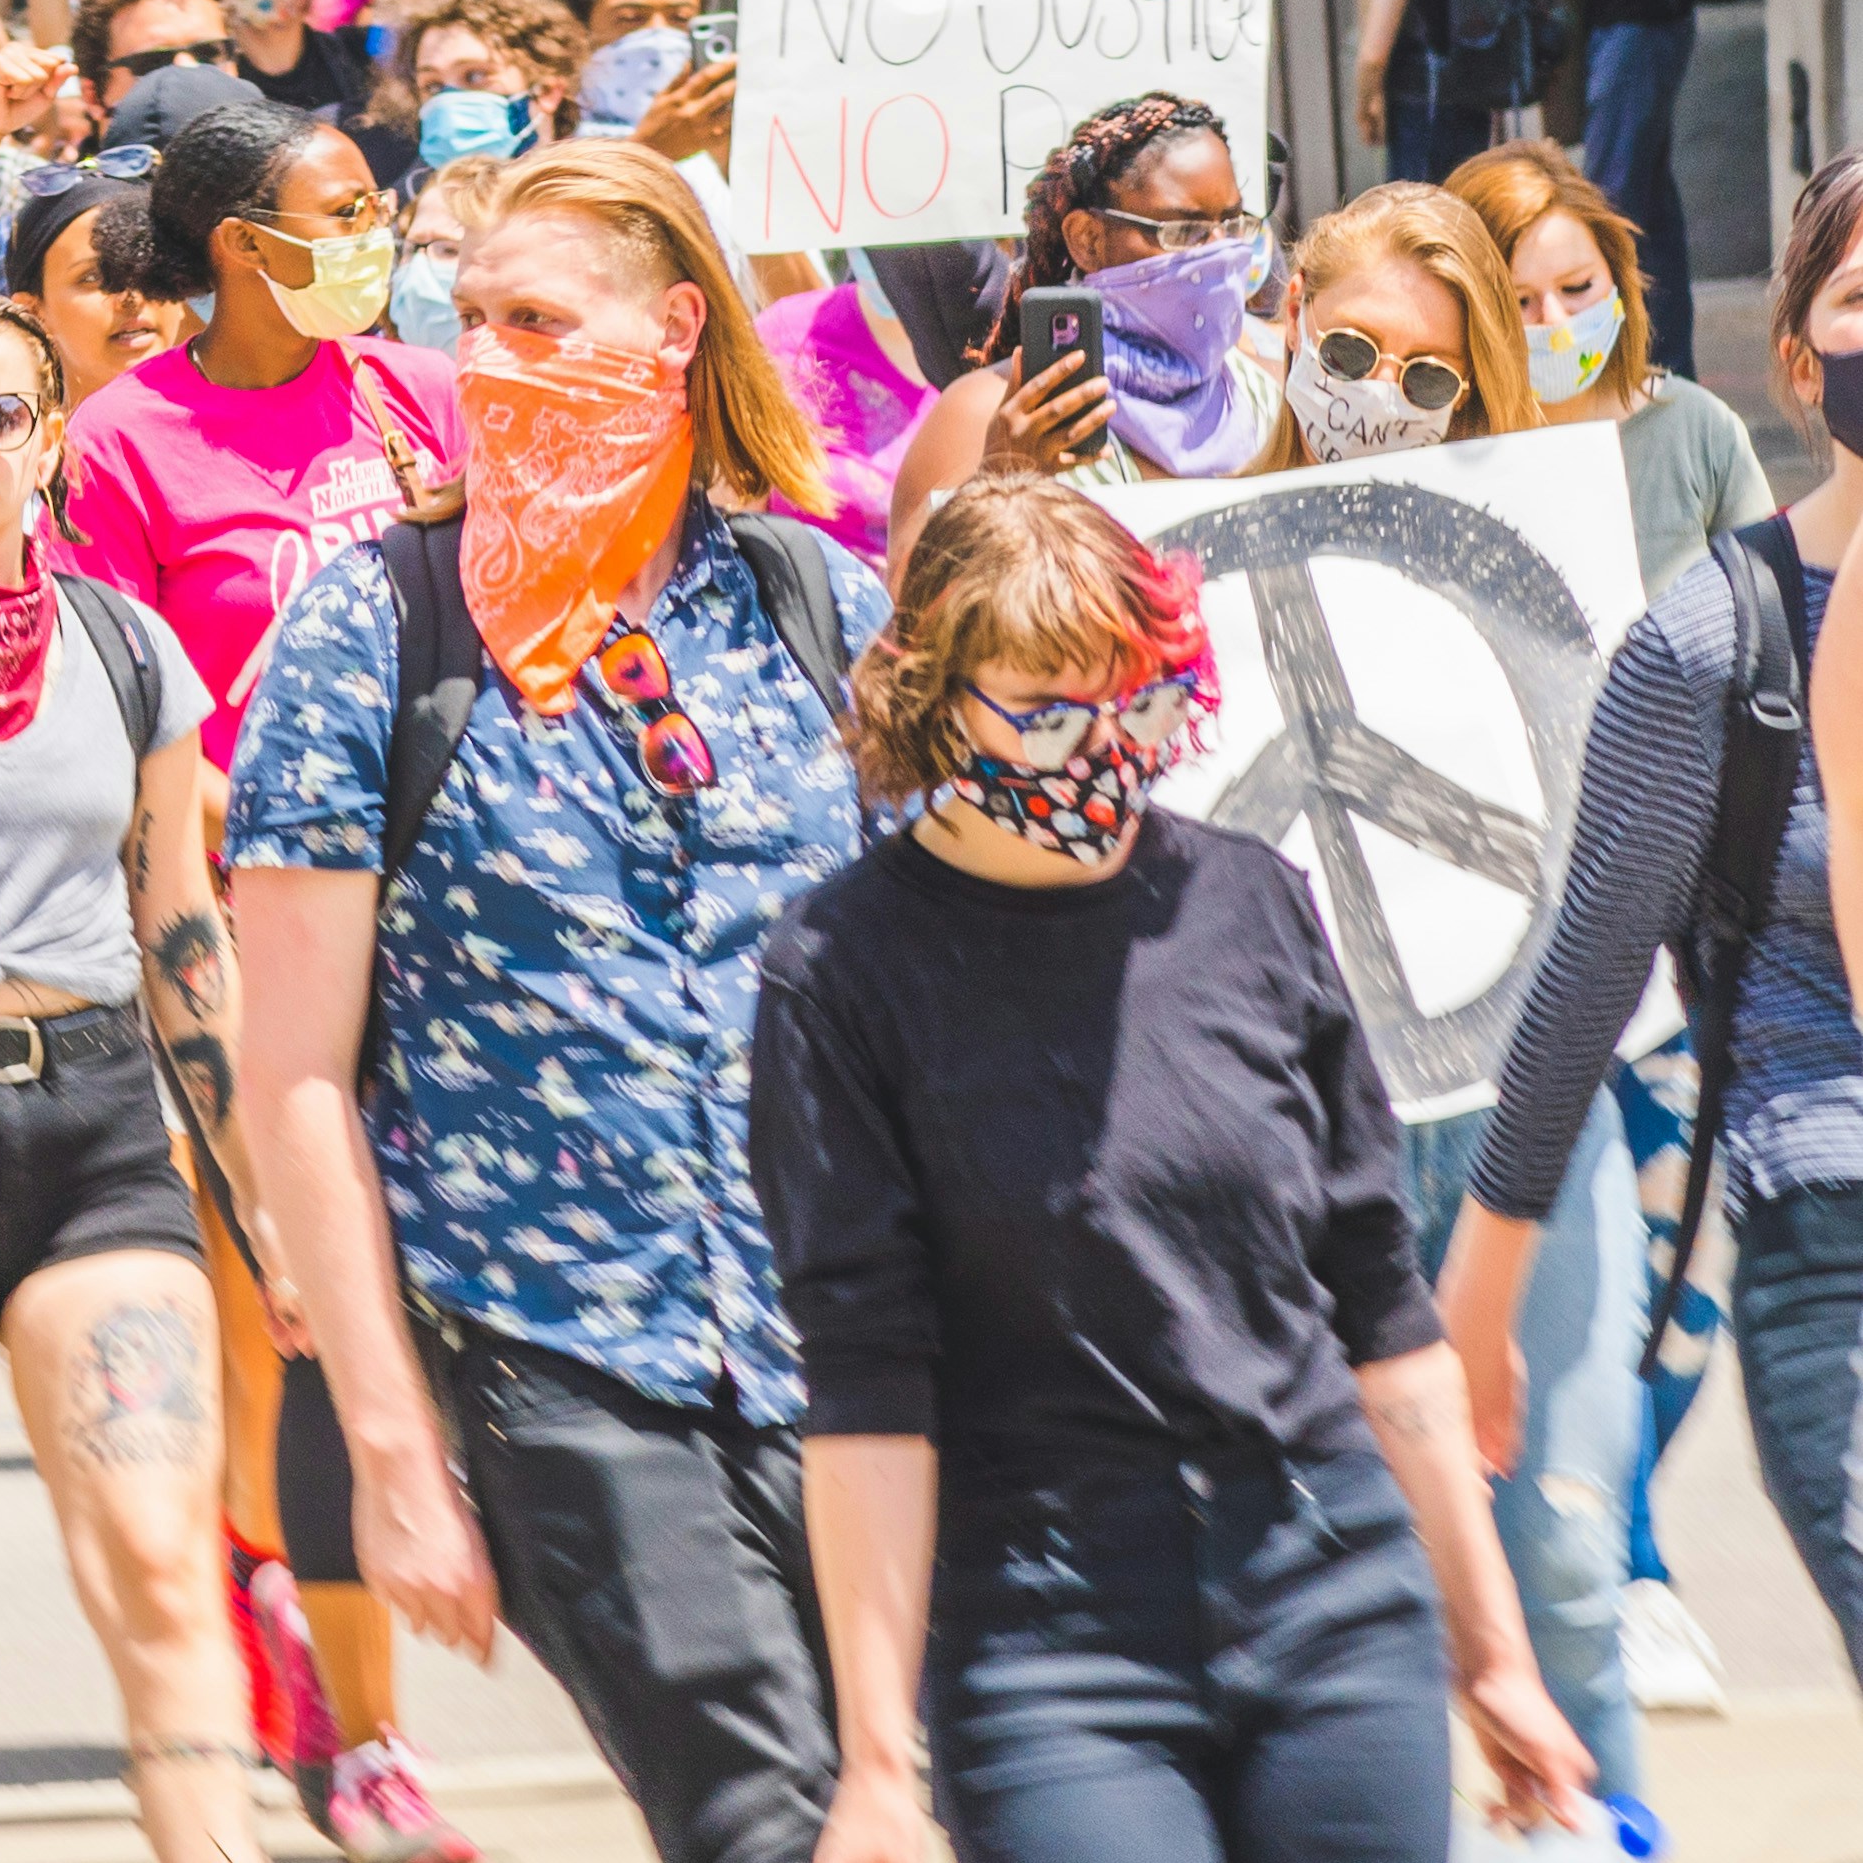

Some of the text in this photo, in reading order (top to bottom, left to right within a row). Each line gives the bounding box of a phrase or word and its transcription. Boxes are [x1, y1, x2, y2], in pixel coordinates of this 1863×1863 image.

[764, 92, 951, 241] NO
[333, 461, 390, 487] MERCY
[315, 480, 381, 513] NORTH
